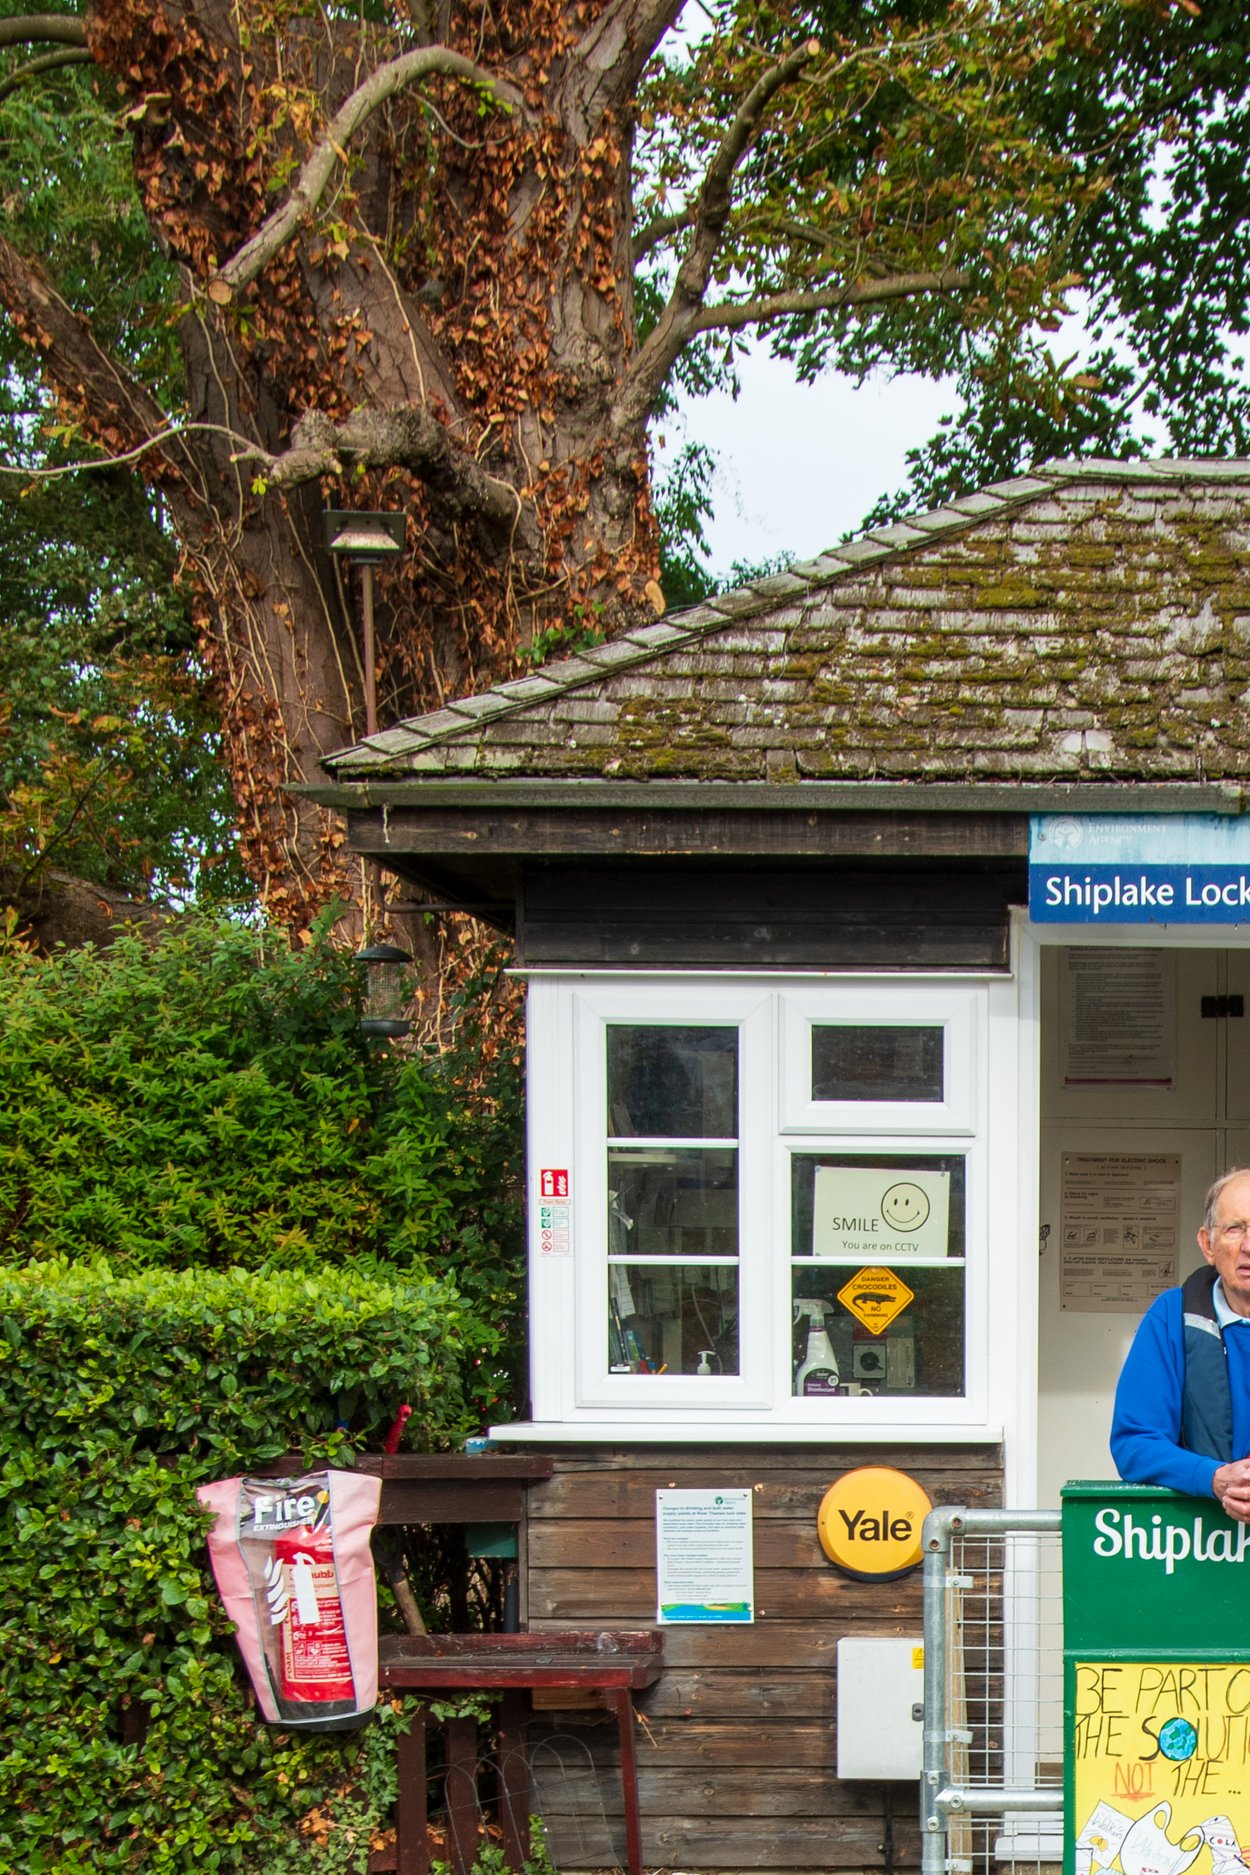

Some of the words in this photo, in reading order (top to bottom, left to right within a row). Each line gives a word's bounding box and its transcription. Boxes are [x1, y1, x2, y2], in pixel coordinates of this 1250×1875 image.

[1046, 876, 1174, 914] Shiplake
[832, 1217, 879, 1232] SMILE
[842, 1240, 860, 1250] You
[862, 1242, 877, 1251] are
[880, 1243, 892, 1251] on
[894, 1242, 919, 1252] CCTV
[253, 1516, 315, 1532] EXTINGUISHER
[254, 1494, 316, 1524] Fire
[838, 1509, 912, 1541] Yale
[1076, 1667, 1123, 1715] BE
[1135, 1668, 1227, 1714] PART
[1076, 1714, 1130, 1760] THE
[1114, 1761, 1159, 1795] NOT
[1171, 1759, 1225, 1797] THE
